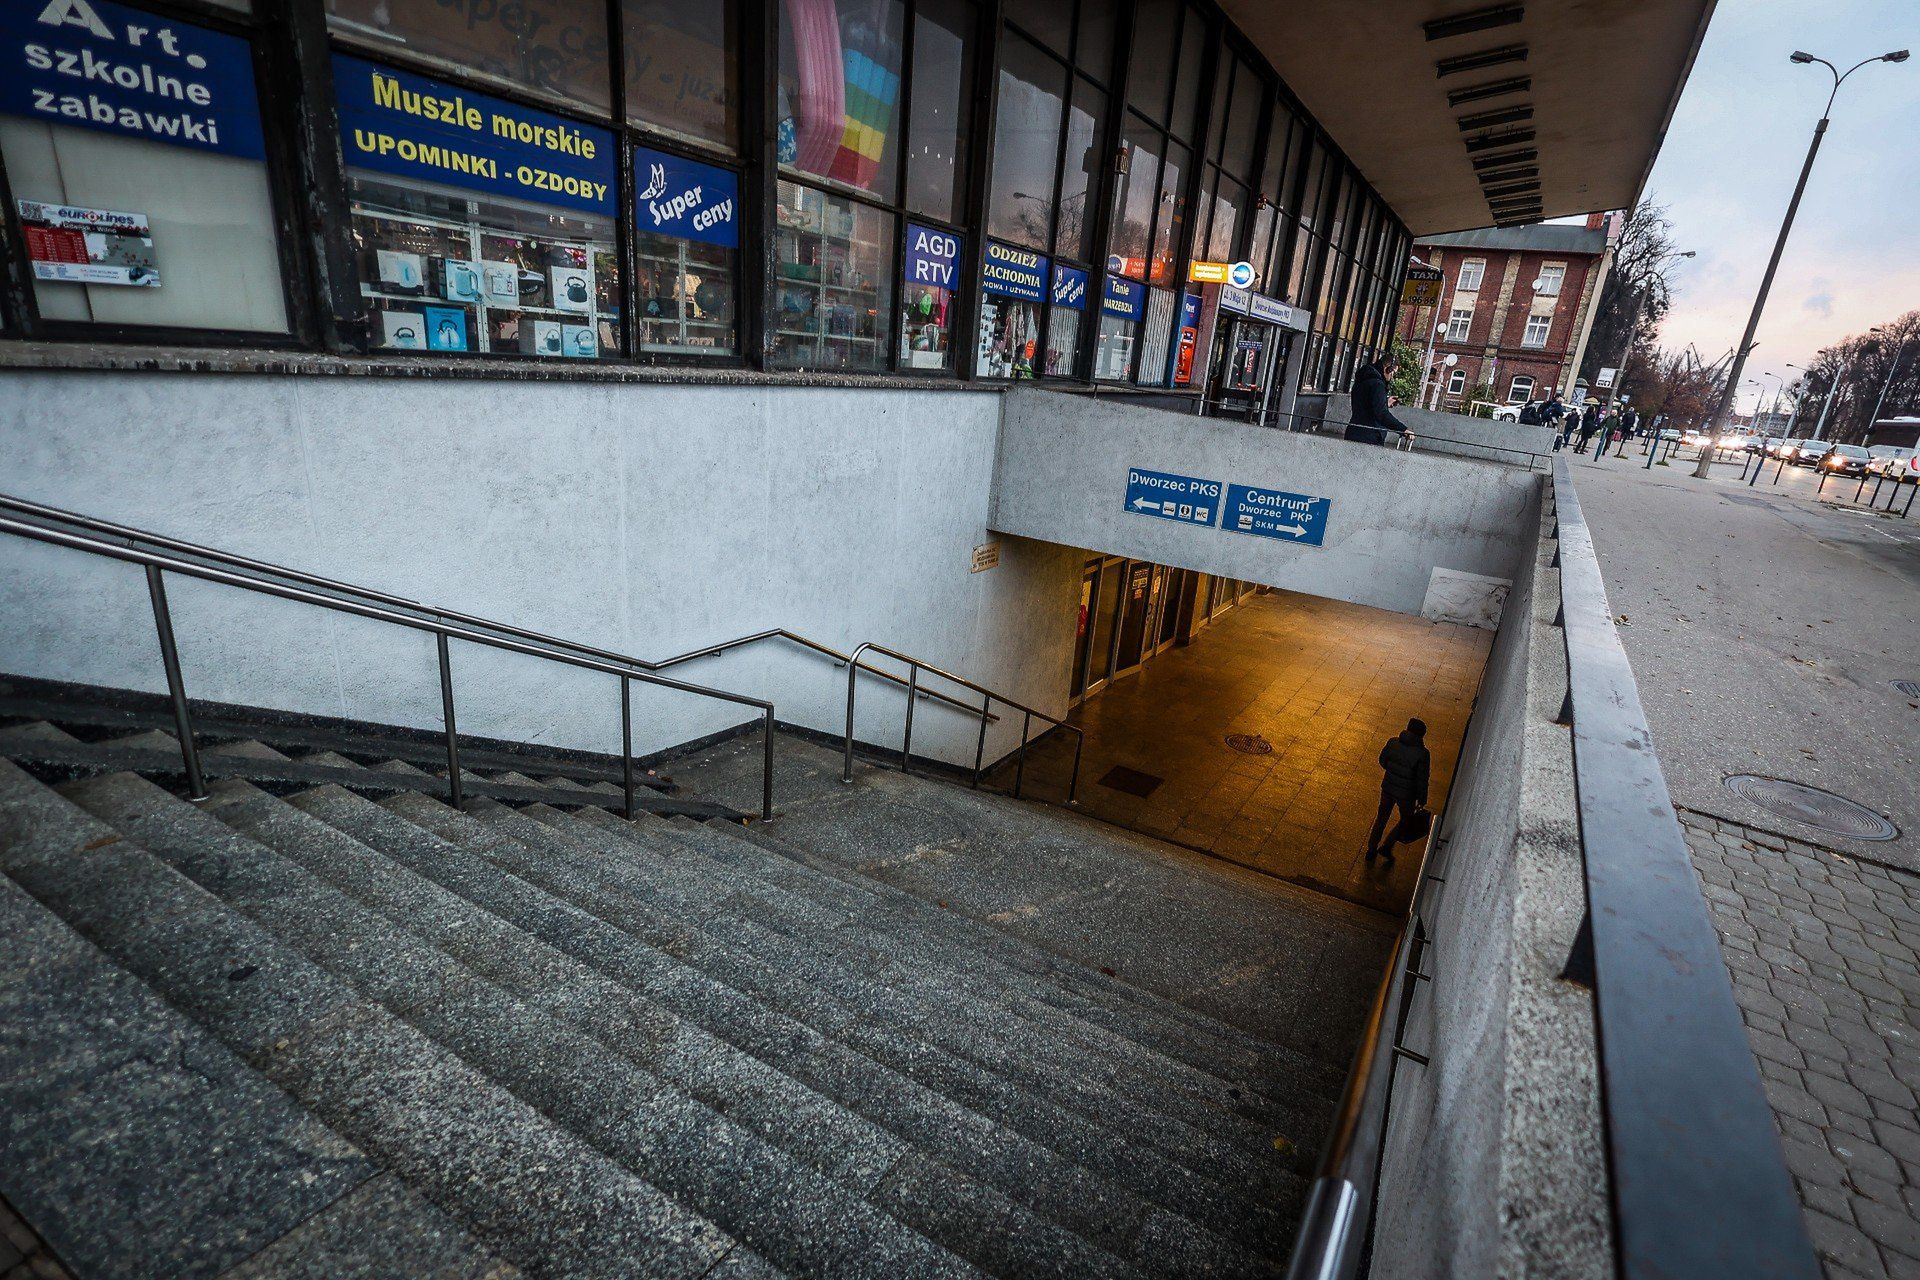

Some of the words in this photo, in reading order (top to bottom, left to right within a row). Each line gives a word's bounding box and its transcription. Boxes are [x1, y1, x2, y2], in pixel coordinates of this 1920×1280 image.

[24, 44, 211, 106] szkolne
[32, 88, 219, 144] zabawki
[373, 73, 482, 131] Muszle
[493, 114, 596, 160] morskie
[355, 129, 497, 180] UPOMINKI
[517, 166, 607, 202] OZDOBY
[649, 185, 703, 226] Super
[692, 197, 733, 232] ceny
[914, 231, 957, 258] AGD
[989, 244, 1039, 269] ODZIEŻ
[915, 258, 953, 285] RTV
[983, 263, 1041, 288] ZACHODNIA
[1412, 271, 1438, 280] TAXI
[1055, 277, 1075, 302] Super
[1068, 282, 1084, 303] ceny
[1112, 280, 1129, 296] Tanie
[1130, 472, 1186, 492] Dworzec
[1190, 481, 1219, 497] PKS
[1239, 503, 1281, 518] Dworzec
[1290, 511, 1313, 523] PKP
[1246, 490, 1310, 512] Centrum
[1196, 511, 1208, 519] WC
[1255, 520, 1275, 530] SKM
